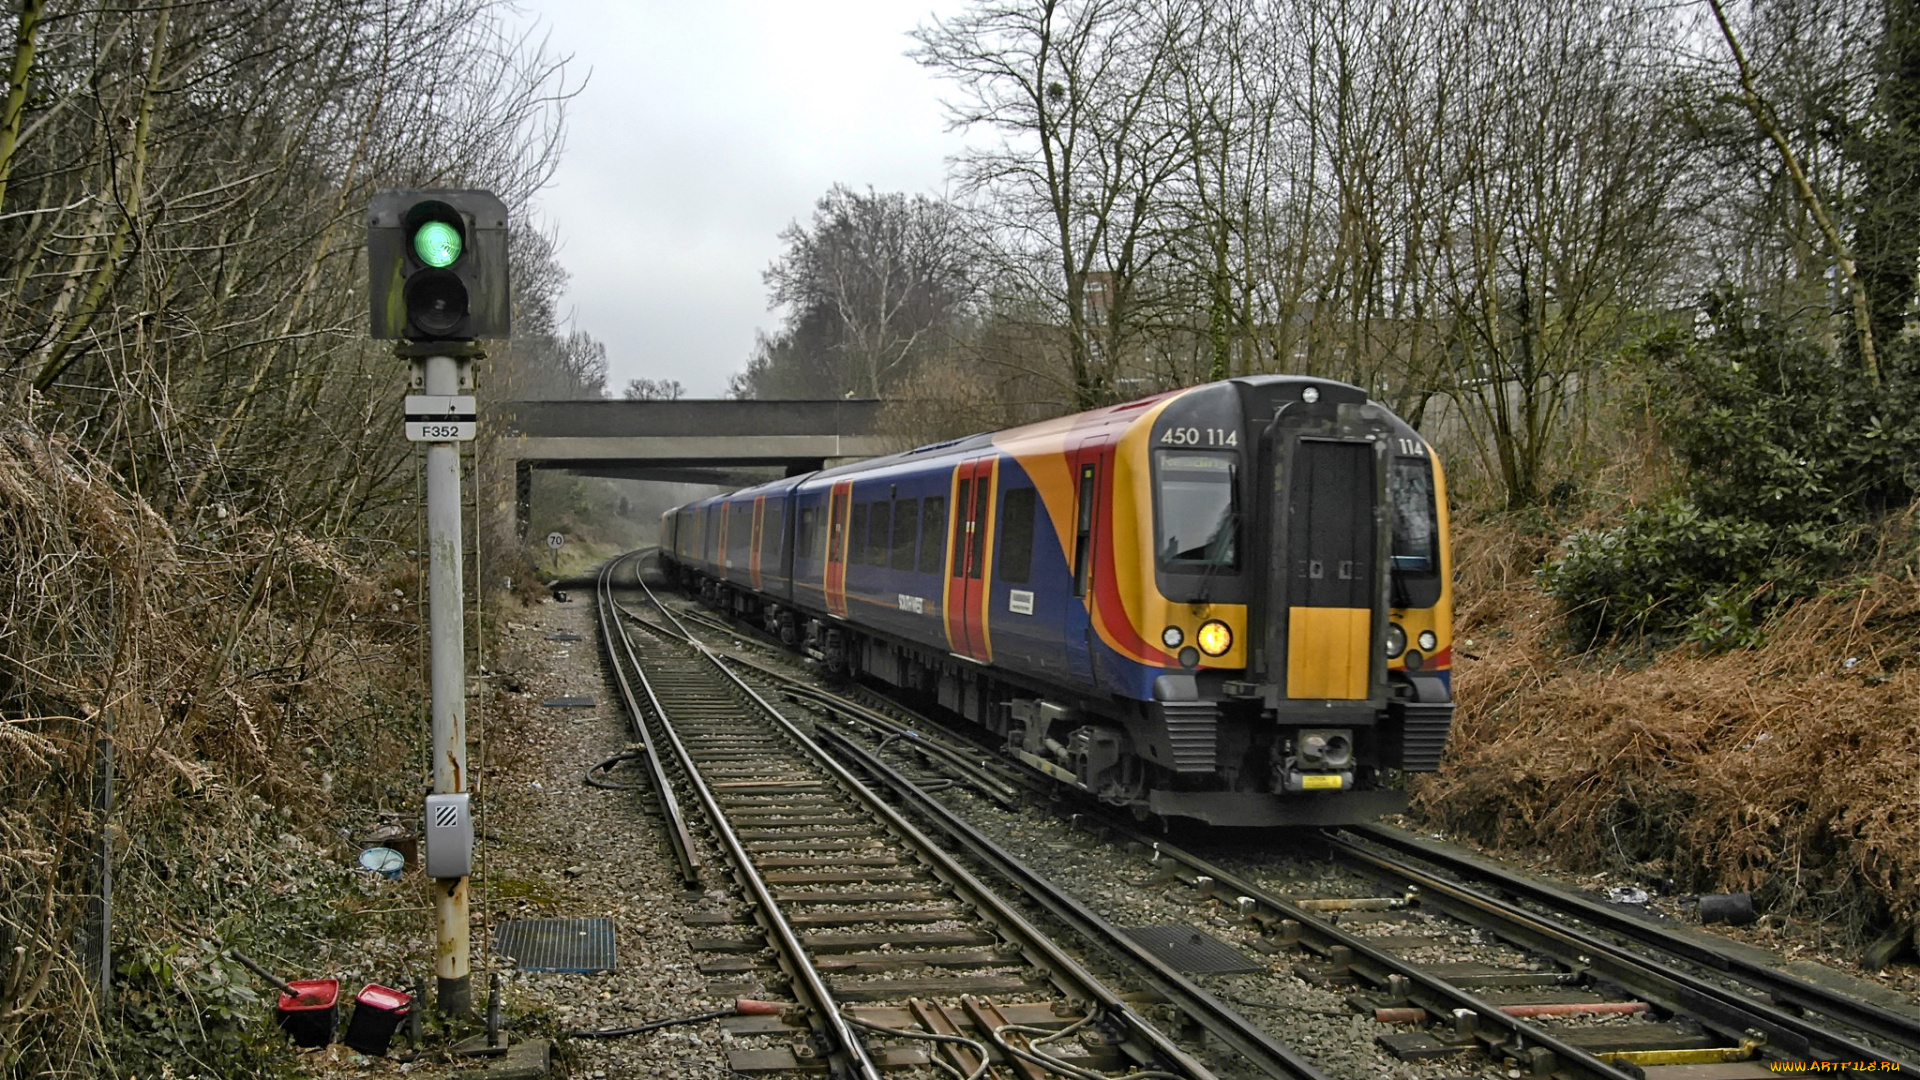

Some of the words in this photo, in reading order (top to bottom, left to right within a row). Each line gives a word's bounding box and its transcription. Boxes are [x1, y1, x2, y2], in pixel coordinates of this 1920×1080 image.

[422, 426, 459, 437] F352
[1160, 427, 1200, 445] 450
[1206, 428, 1238, 446] 114
[1399, 438, 1423, 456] 114
[550, 536, 562, 545] 70
